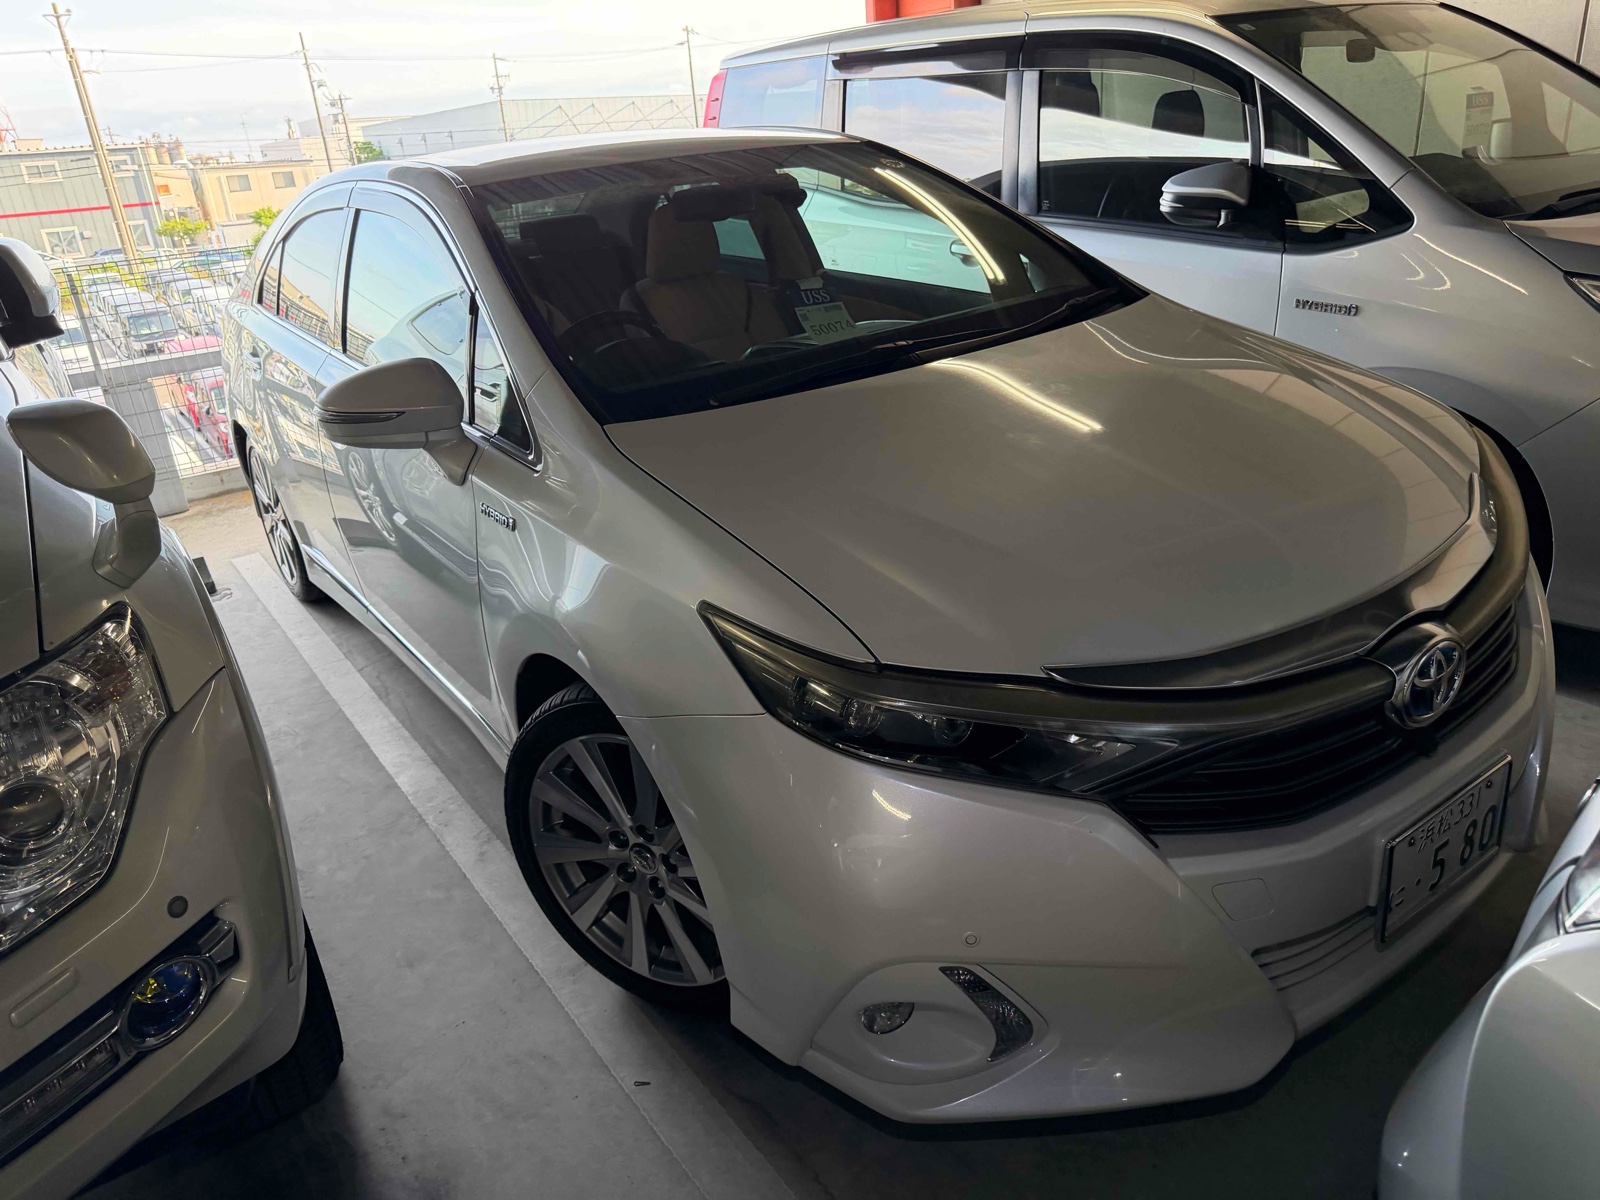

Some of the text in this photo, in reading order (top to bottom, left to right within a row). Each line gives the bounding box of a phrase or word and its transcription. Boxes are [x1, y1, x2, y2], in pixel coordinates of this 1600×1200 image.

[1472, 95, 1489, 107] USS
[801, 289, 830, 304] USS
[1293, 298, 1348, 316] HYBRID
[810, 319, 856, 336] 50074
[480, 502, 509, 529] HYBRID
